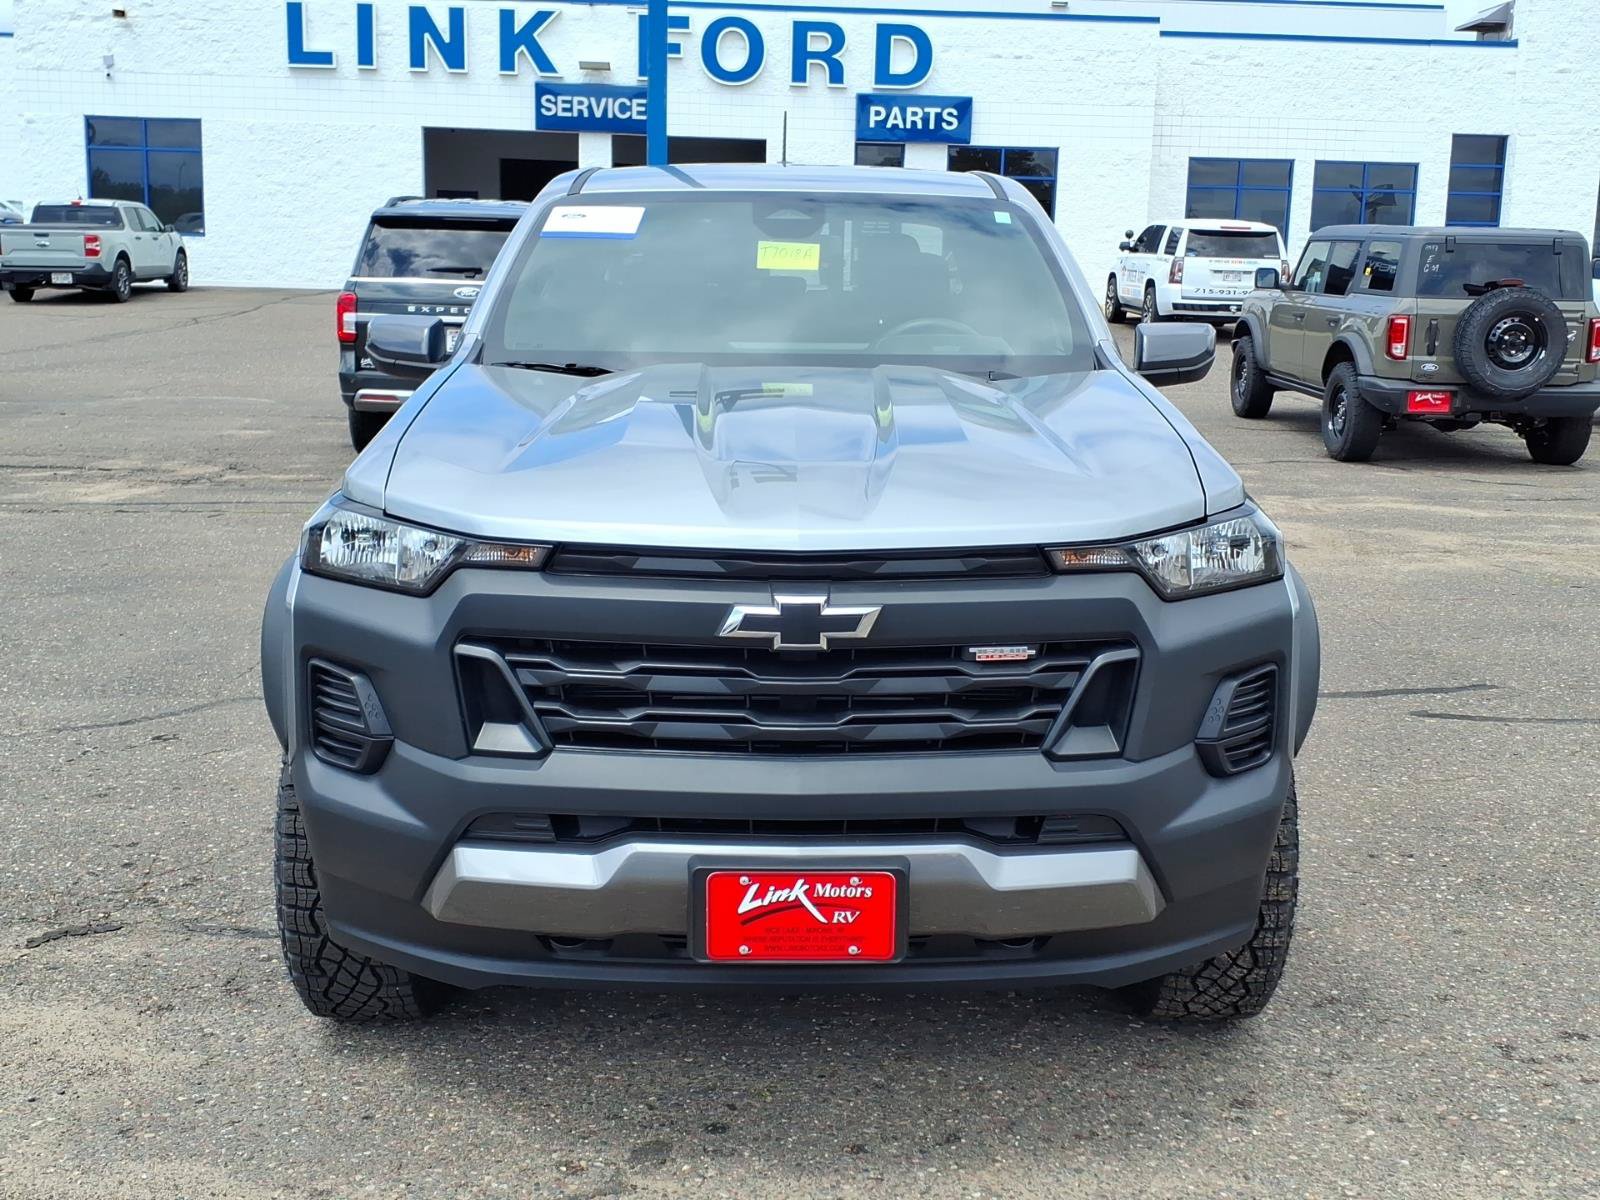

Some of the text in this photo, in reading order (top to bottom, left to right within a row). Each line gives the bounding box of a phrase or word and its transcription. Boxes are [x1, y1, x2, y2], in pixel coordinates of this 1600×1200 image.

[286, 1, 935, 89] LINK FORD
[540, 94, 647, 120] SERVICE
[868, 106, 959, 131] PARTS
[737, 878, 873, 924] Link Motors
[831, 911, 861, 924] RV
